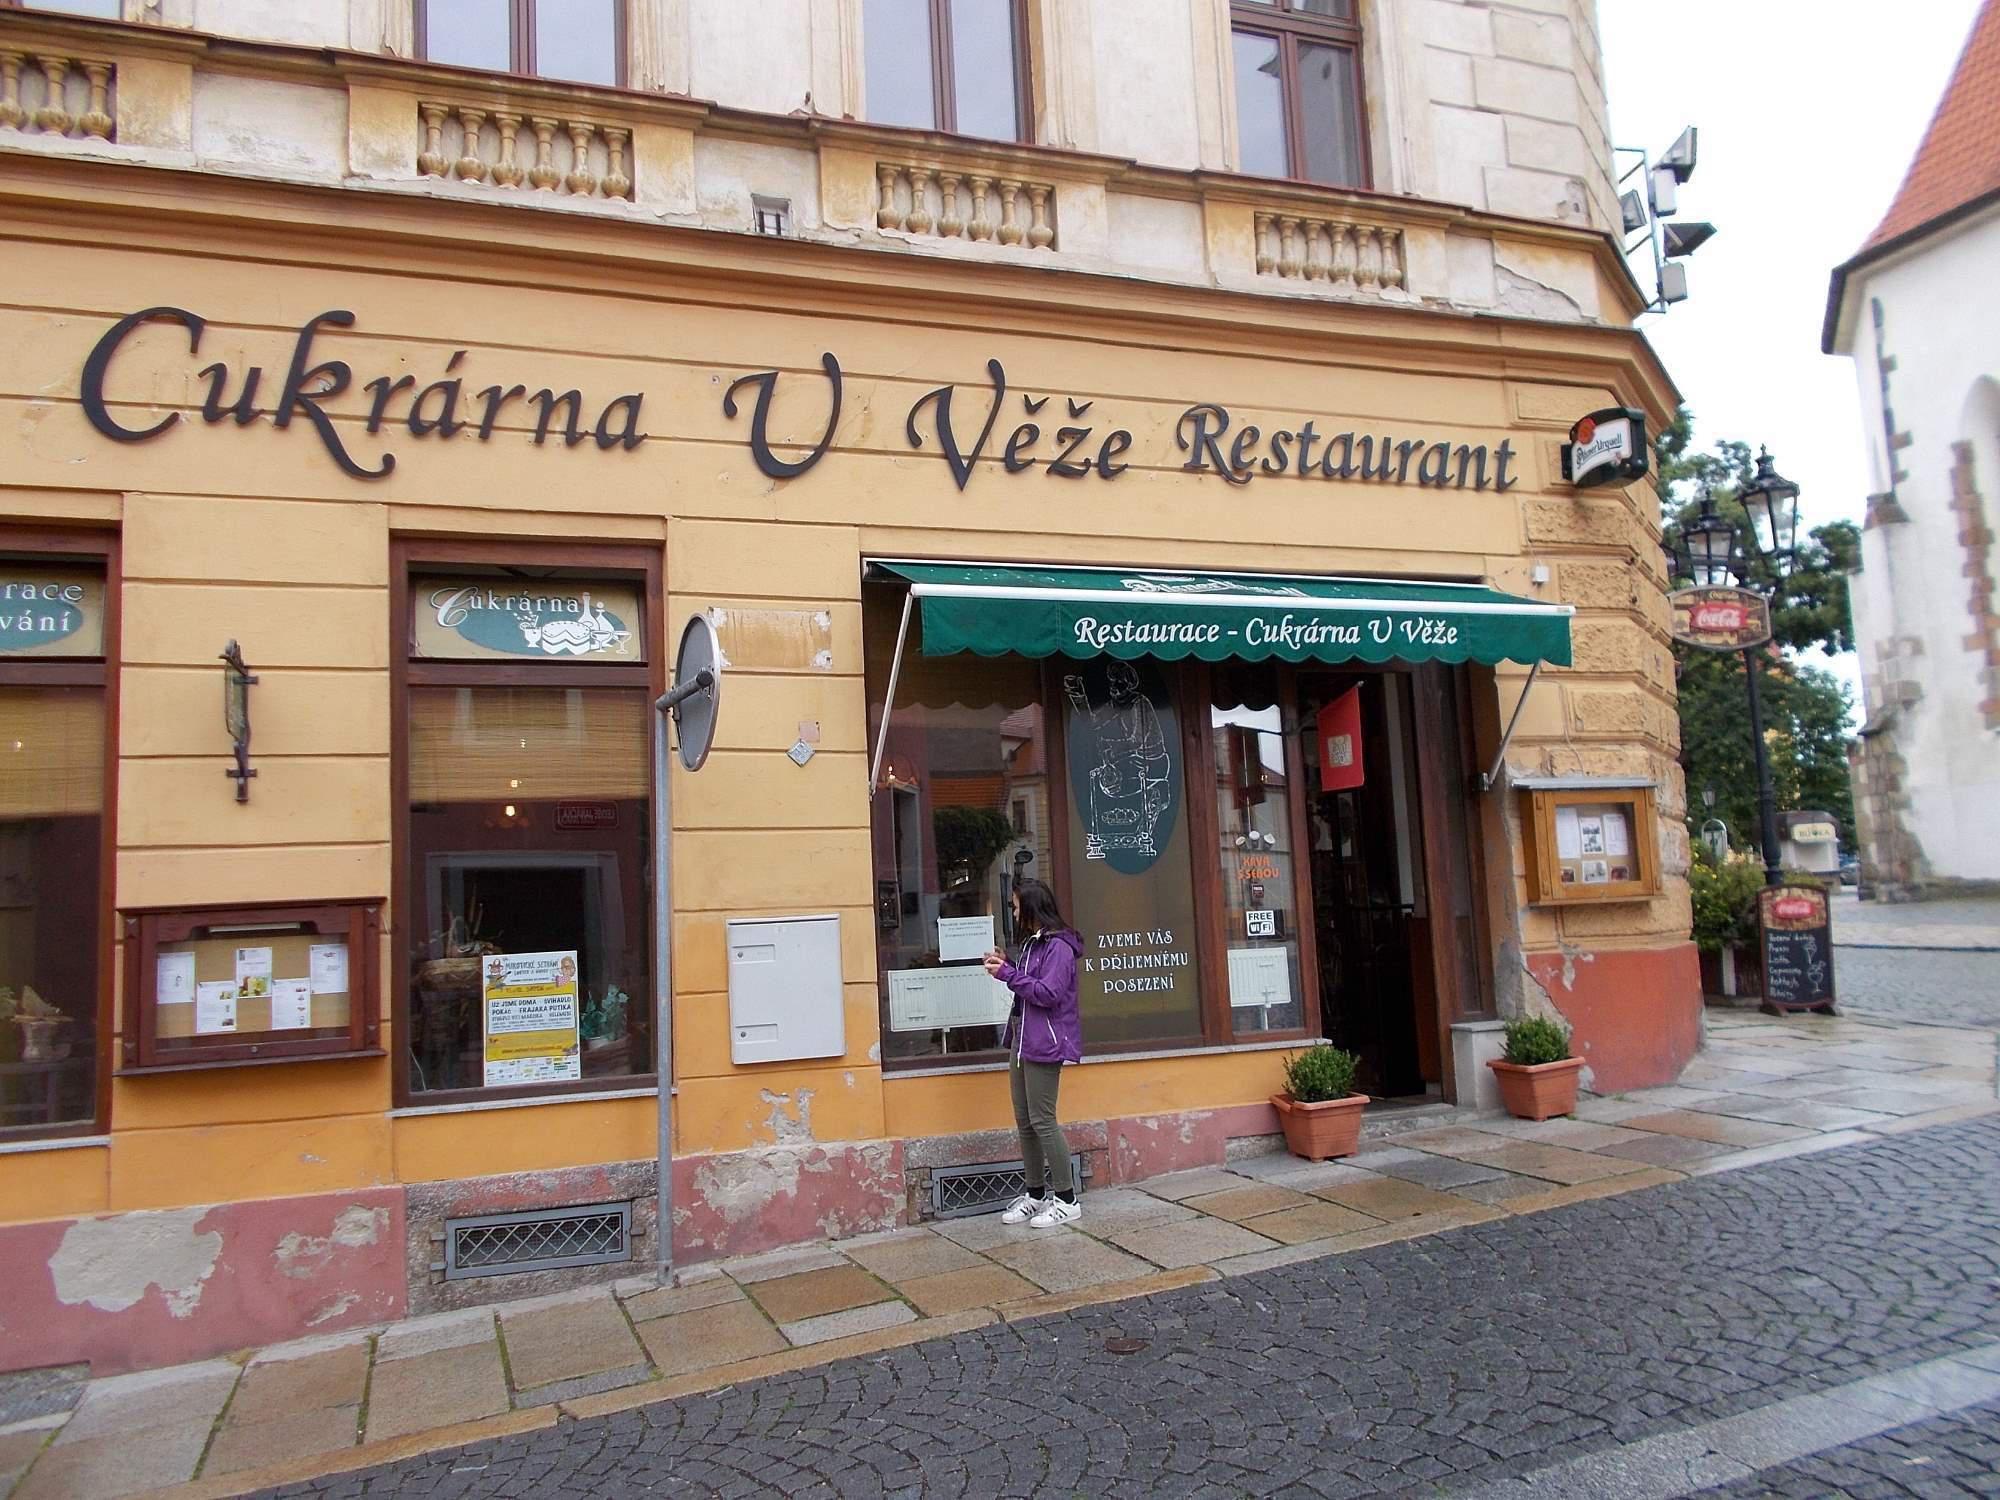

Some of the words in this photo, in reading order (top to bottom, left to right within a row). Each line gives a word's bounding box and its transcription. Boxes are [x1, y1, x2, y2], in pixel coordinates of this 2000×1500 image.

[79, 306, 648, 481] Cukrárna
[723, 351, 843, 479] U
[906, 358, 1132, 492] Věže
[1175, 402, 1519, 494] Restaurant
[430, 586, 580, 628] Cukrárna
[1073, 616, 1220, 649] Restaurace
[1245, 614, 1361, 650] Cukrárna
[1368, 615, 1393, 644] U
[1400, 616, 1458, 644] Věže
[1248, 911, 1273, 921] FREE
[1098, 932, 1143, 948] ZVEME
[1147, 928, 1174, 945] VÁS
[1085, 958, 1095, 972] K
[1100, 949, 1189, 971] PŘÍJEMNÉMU
[1103, 972, 1175, 994] POSEZENÍ
